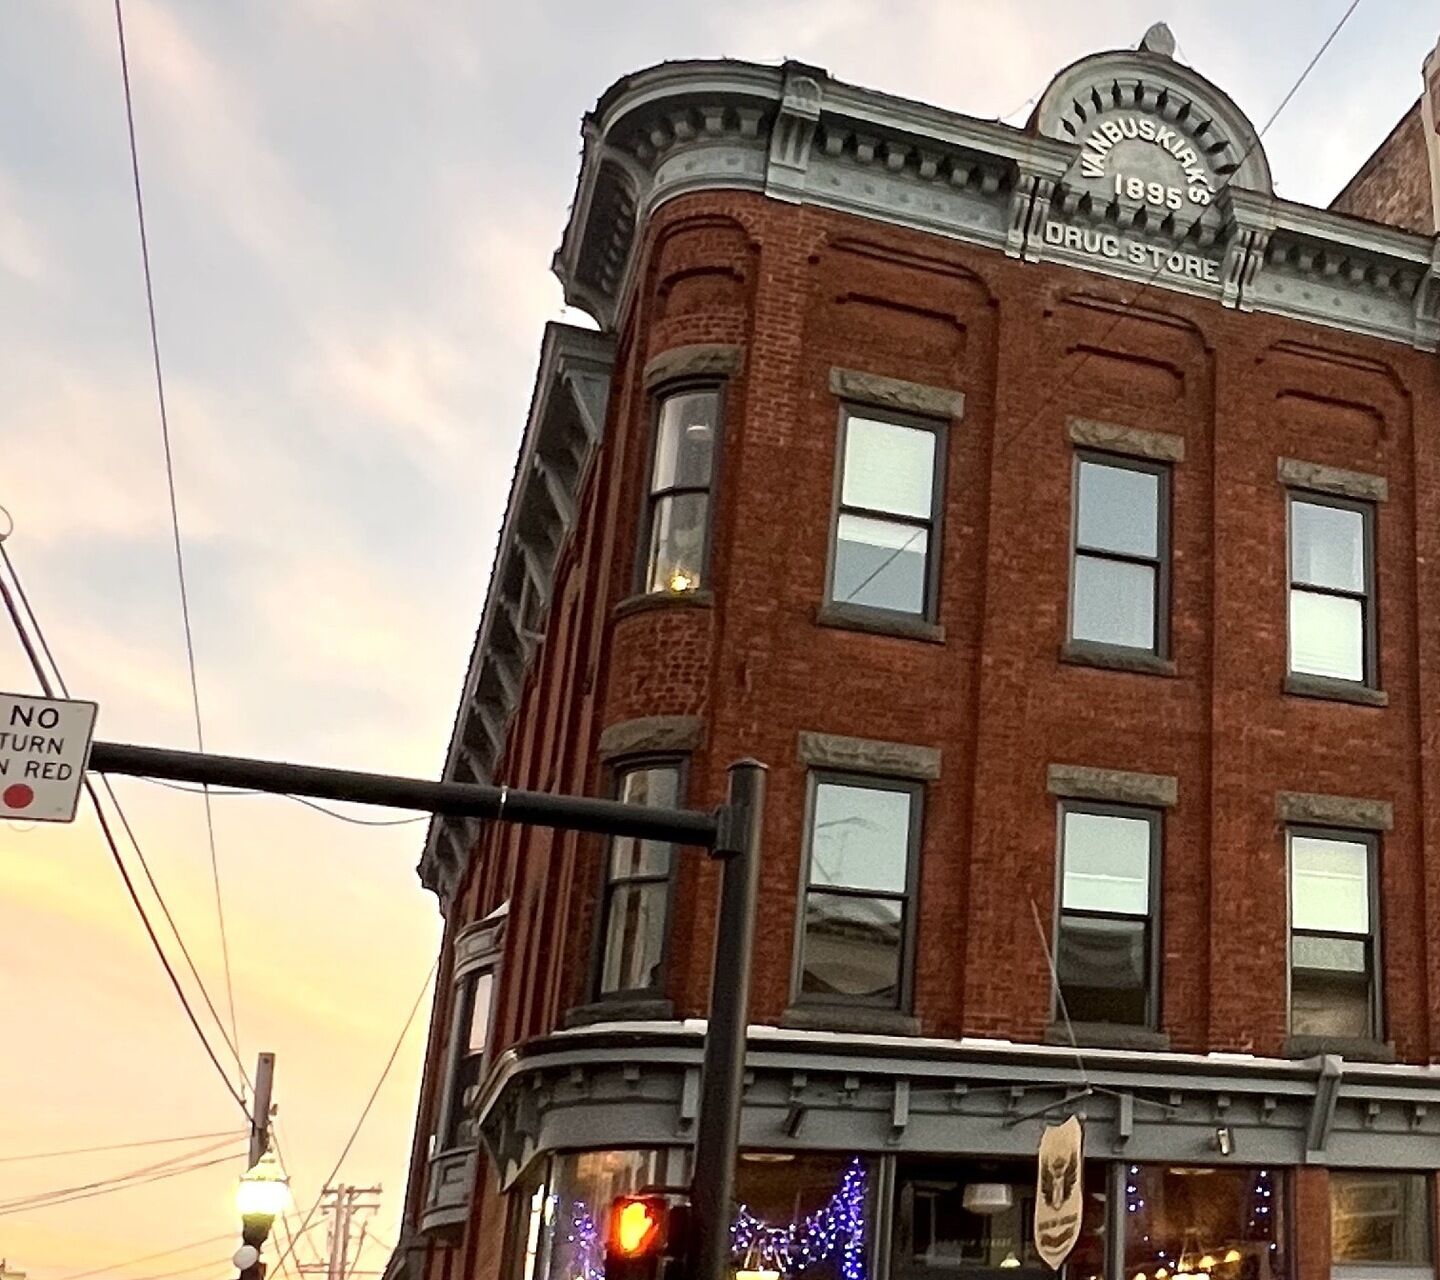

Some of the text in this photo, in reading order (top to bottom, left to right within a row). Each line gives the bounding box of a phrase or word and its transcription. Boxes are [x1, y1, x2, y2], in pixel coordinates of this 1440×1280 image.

[1081, 118, 1216, 206] VANBUSKIRK'S
[1115, 173, 1183, 210] 1895
[1045, 221, 1220, 282] DRUG STORE
[10, 705, 59, 729] NO
[0, 732, 64, 755] TURN
[0, 759, 72, 781] N RED
